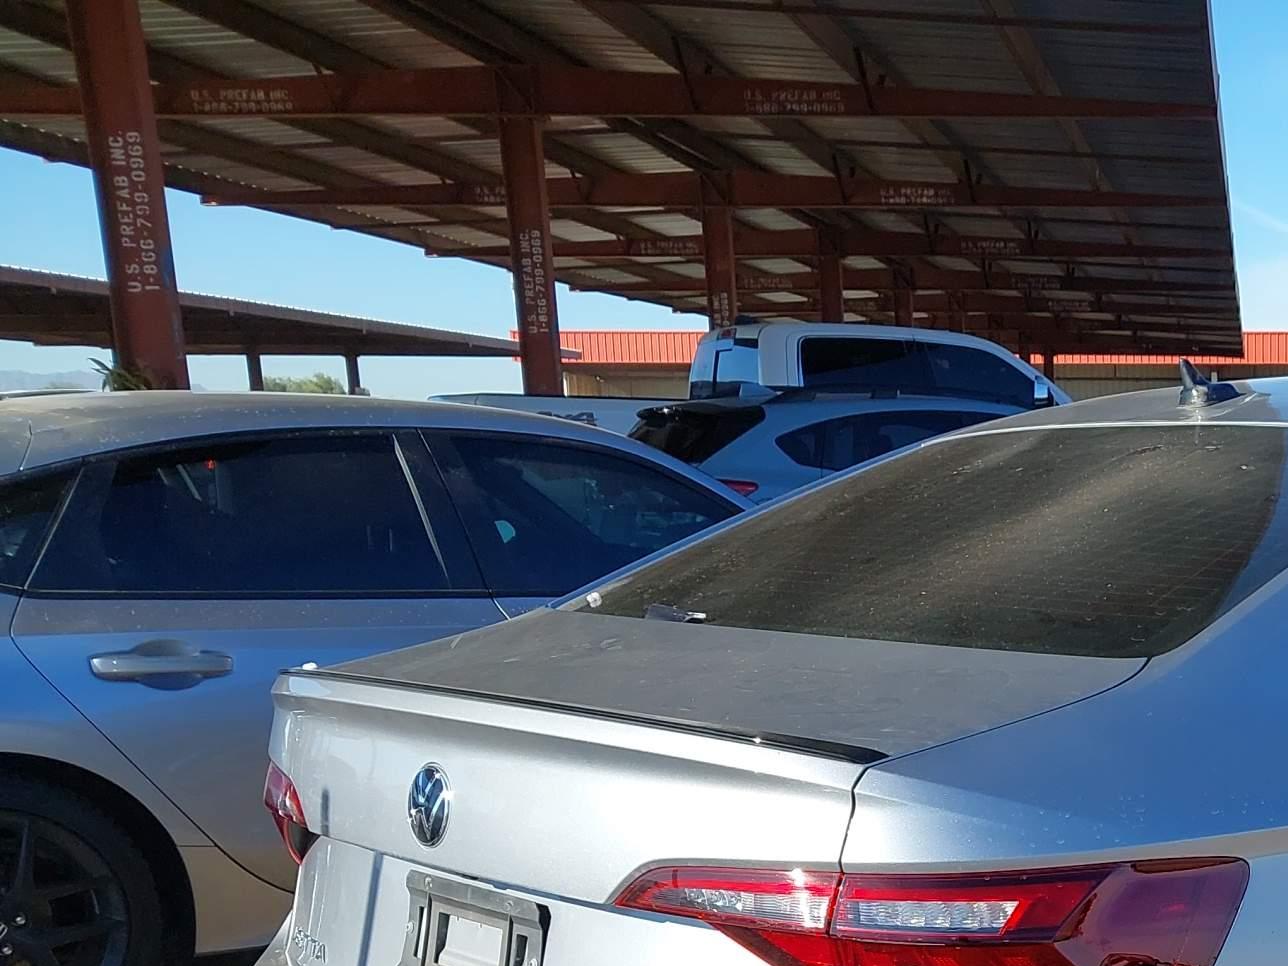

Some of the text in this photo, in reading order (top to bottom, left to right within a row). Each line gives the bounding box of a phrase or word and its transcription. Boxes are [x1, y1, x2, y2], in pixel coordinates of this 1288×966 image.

[108, 130, 142, 293] U.S. PREFAB INC.
[126, 131, 161, 291] 1-866-799-0969
[519, 228, 531, 252] INC.
[521, 257, 536, 305] PREFAB
